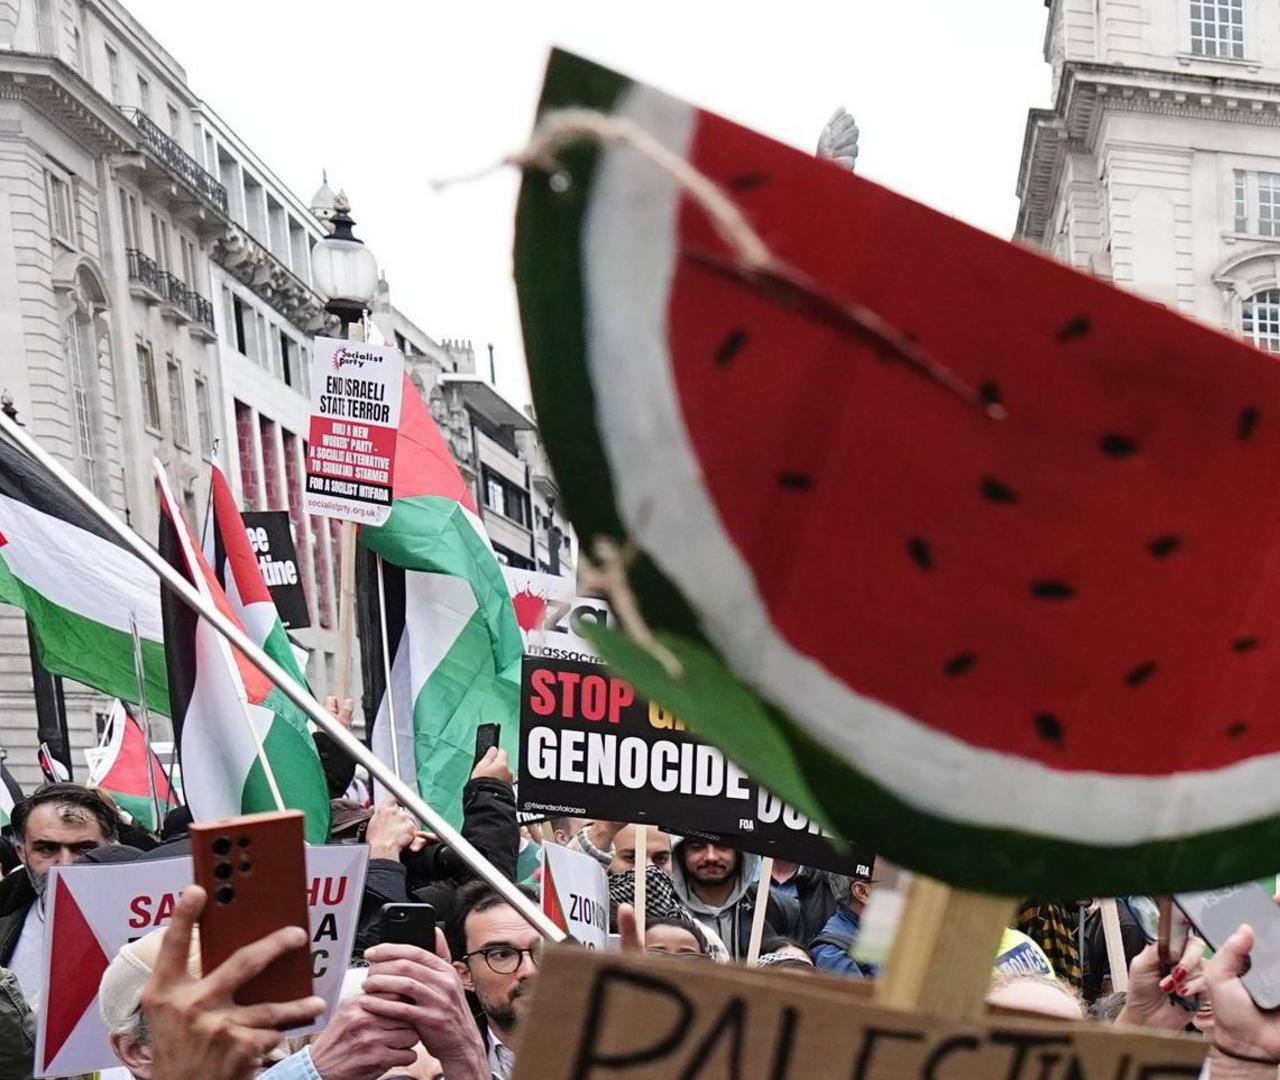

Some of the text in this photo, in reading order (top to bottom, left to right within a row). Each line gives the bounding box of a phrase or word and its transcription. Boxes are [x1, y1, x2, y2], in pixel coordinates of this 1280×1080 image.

[342, 348, 383, 364] Socialist
[326, 376, 385, 402] END ISRAELI
[319, 395, 390, 423] STATE TERROR
[309, 477, 323, 491] FOR
[324, 479, 331, 492] A
[530, 668, 634, 724] STOP
[527, 726, 750, 800] GENOCIDE
[739, 818, 754, 832] FOA
[856, 864, 870, 878] FOA
